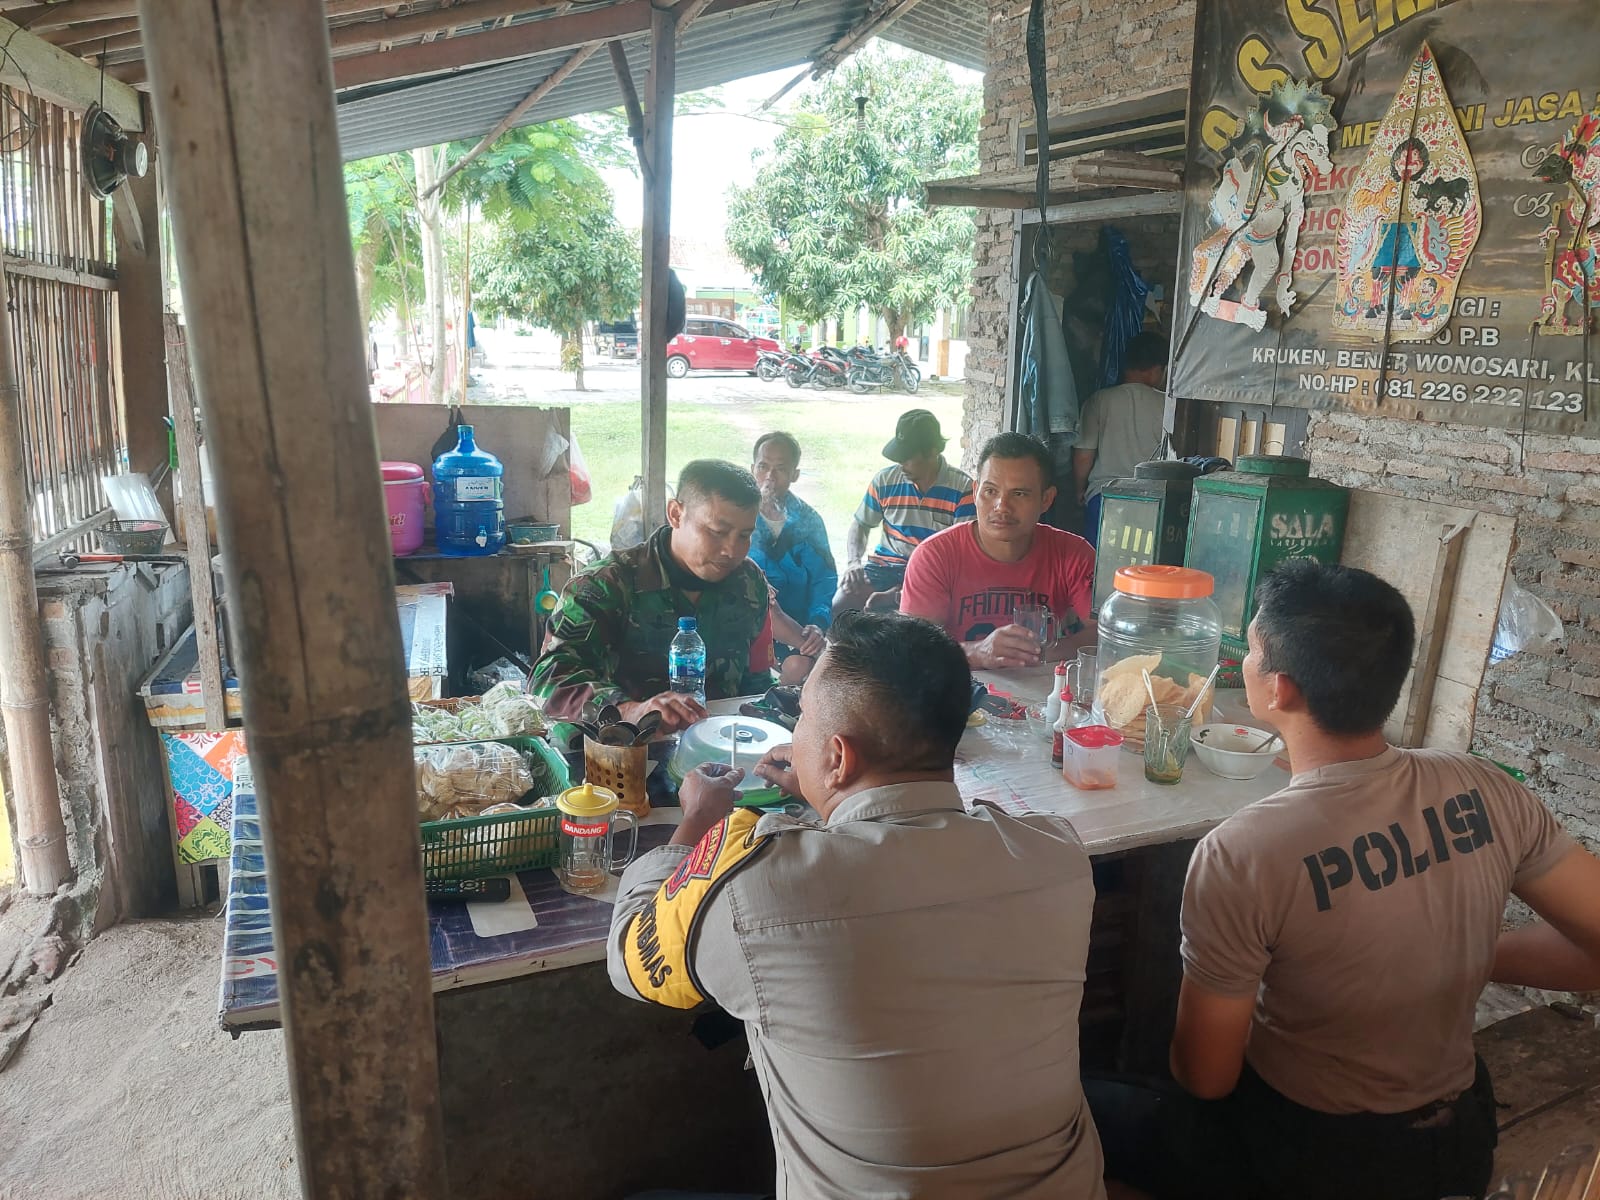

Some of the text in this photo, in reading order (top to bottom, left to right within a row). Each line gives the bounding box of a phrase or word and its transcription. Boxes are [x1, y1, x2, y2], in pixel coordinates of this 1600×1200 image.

[1494, 88, 1584, 128] JASA
[1460, 327, 1500, 347] P.B
[1252, 347, 1331, 370] KRUKEN,
[1415, 352, 1556, 384] WONOSARI,
[1299, 374, 1358, 394] NO.HP
[1421, 382, 1468, 402] 226
[1472, 384, 1525, 407] 222
[1528, 388, 1584, 414] 123
[564, 823, 603, 836] DANDANG
[1303, 788, 1495, 913] POLISI
